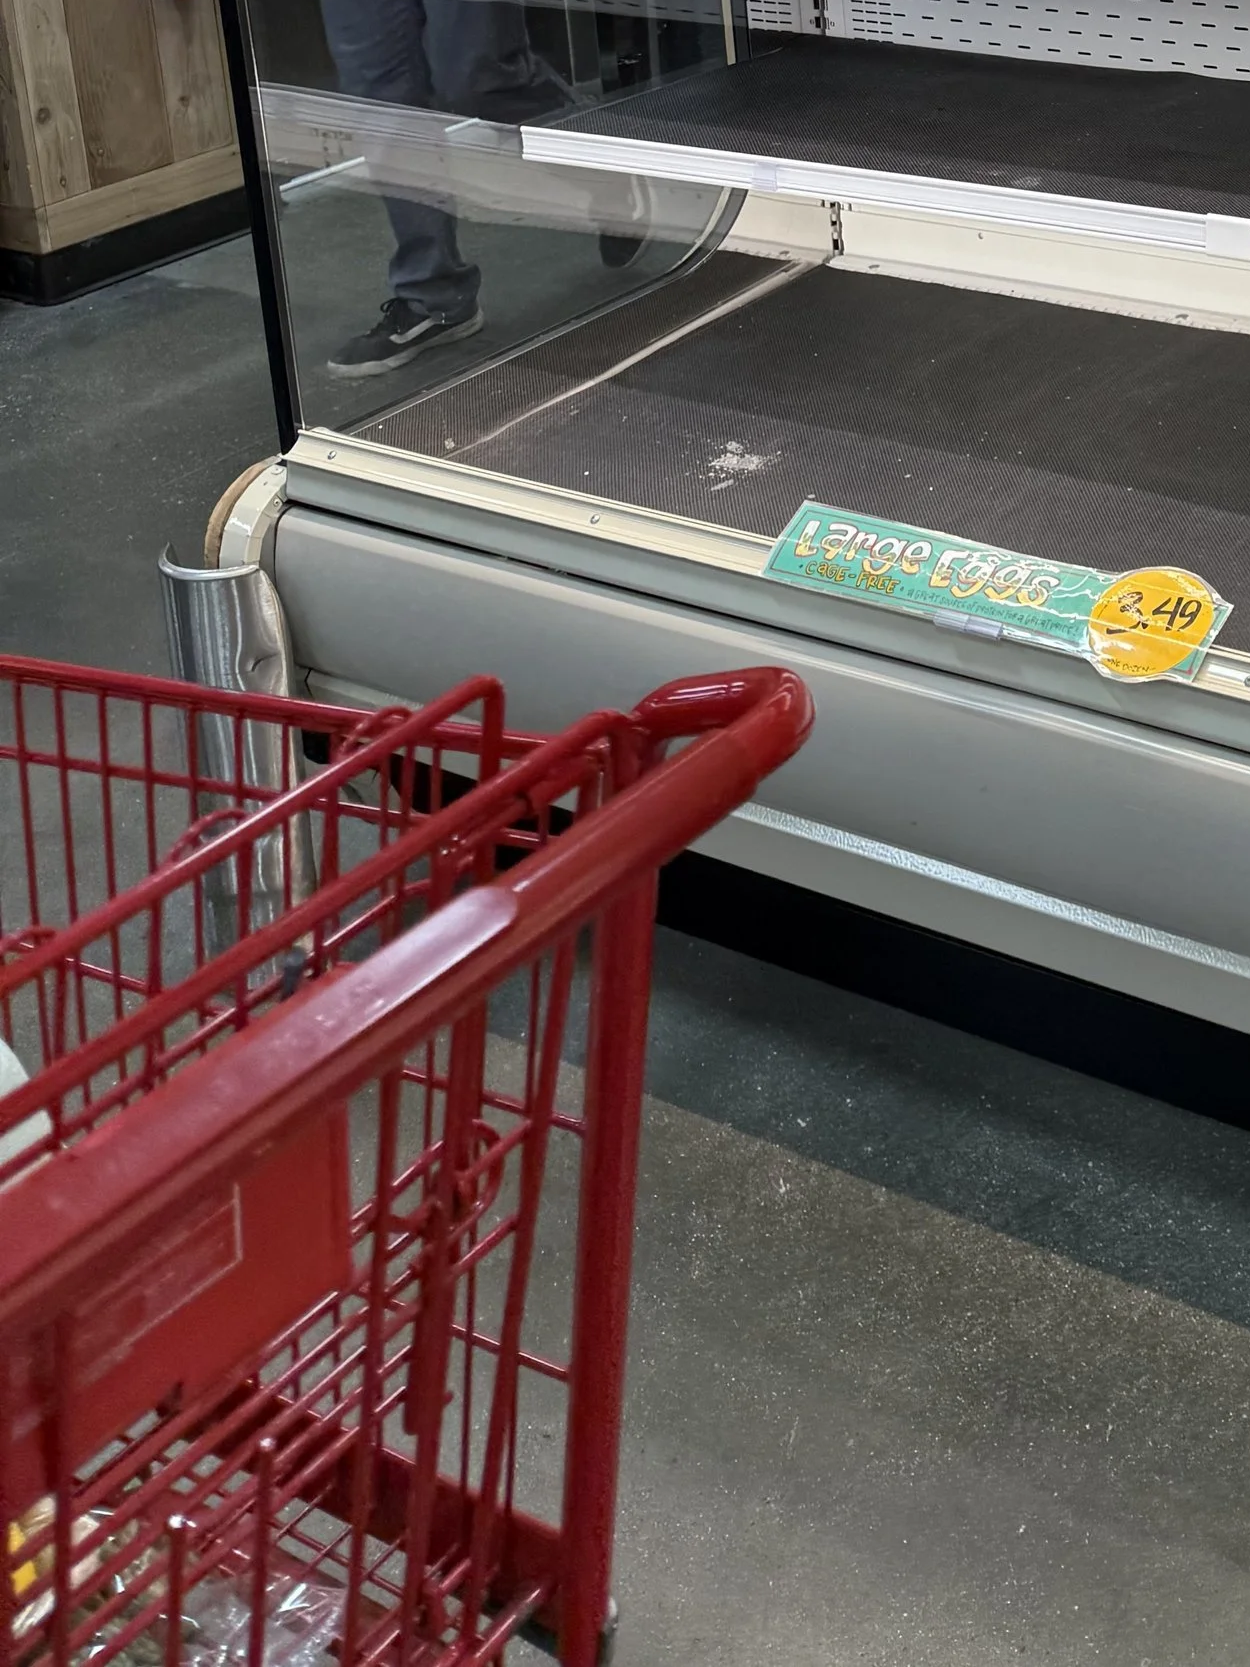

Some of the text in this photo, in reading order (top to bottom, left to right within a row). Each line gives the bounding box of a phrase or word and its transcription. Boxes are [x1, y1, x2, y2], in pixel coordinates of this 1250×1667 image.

[794, 520, 1062, 607] Large Eggs
[1106, 591, 1202, 634] 3.49
